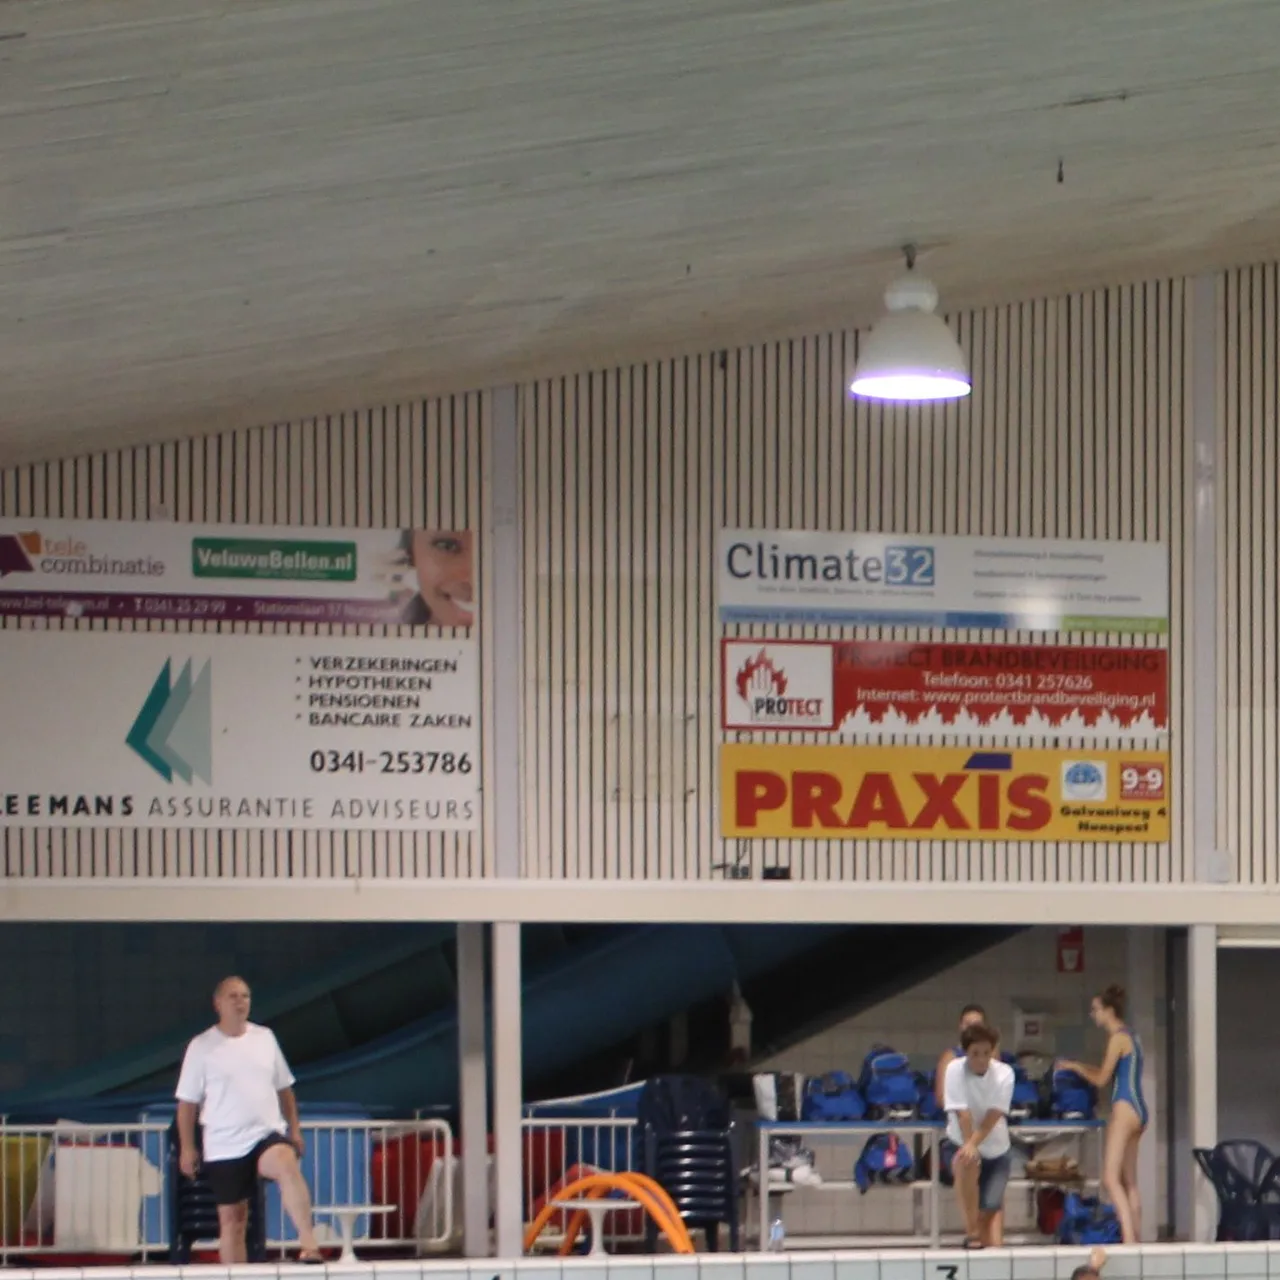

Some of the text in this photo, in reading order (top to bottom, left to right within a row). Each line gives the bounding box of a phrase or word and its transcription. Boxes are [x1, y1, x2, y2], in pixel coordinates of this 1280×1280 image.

[44, 536, 87, 557] tele
[40, 554, 165, 577] combinatie
[196, 547, 354, 572] VeluweBellen.nl
[726, 541, 936, 586] Climate32
[309, 656, 458, 674] VERZEKERINGEN
[941, 648, 1160, 672] BRANDBEVEILIGING
[308, 675, 432, 691] HYPOTHEKEN
[922, 670, 1093, 690] Telefoon: 0341 257626
[308, 692, 421, 709] PENSIOENEN
[754, 697, 823, 716] PROTECT
[857, 687, 1156, 709] Internet: www.protectbrandbeveiliging.nl
[308, 711, 473, 729] BANCAIRE ZAKEN
[309, 749, 473, 775] 0341-253786
[0, 794, 474, 821] EEMANS ASSURANTIE ADVISEURS
[734, 768, 1052, 832] PRAXIS
